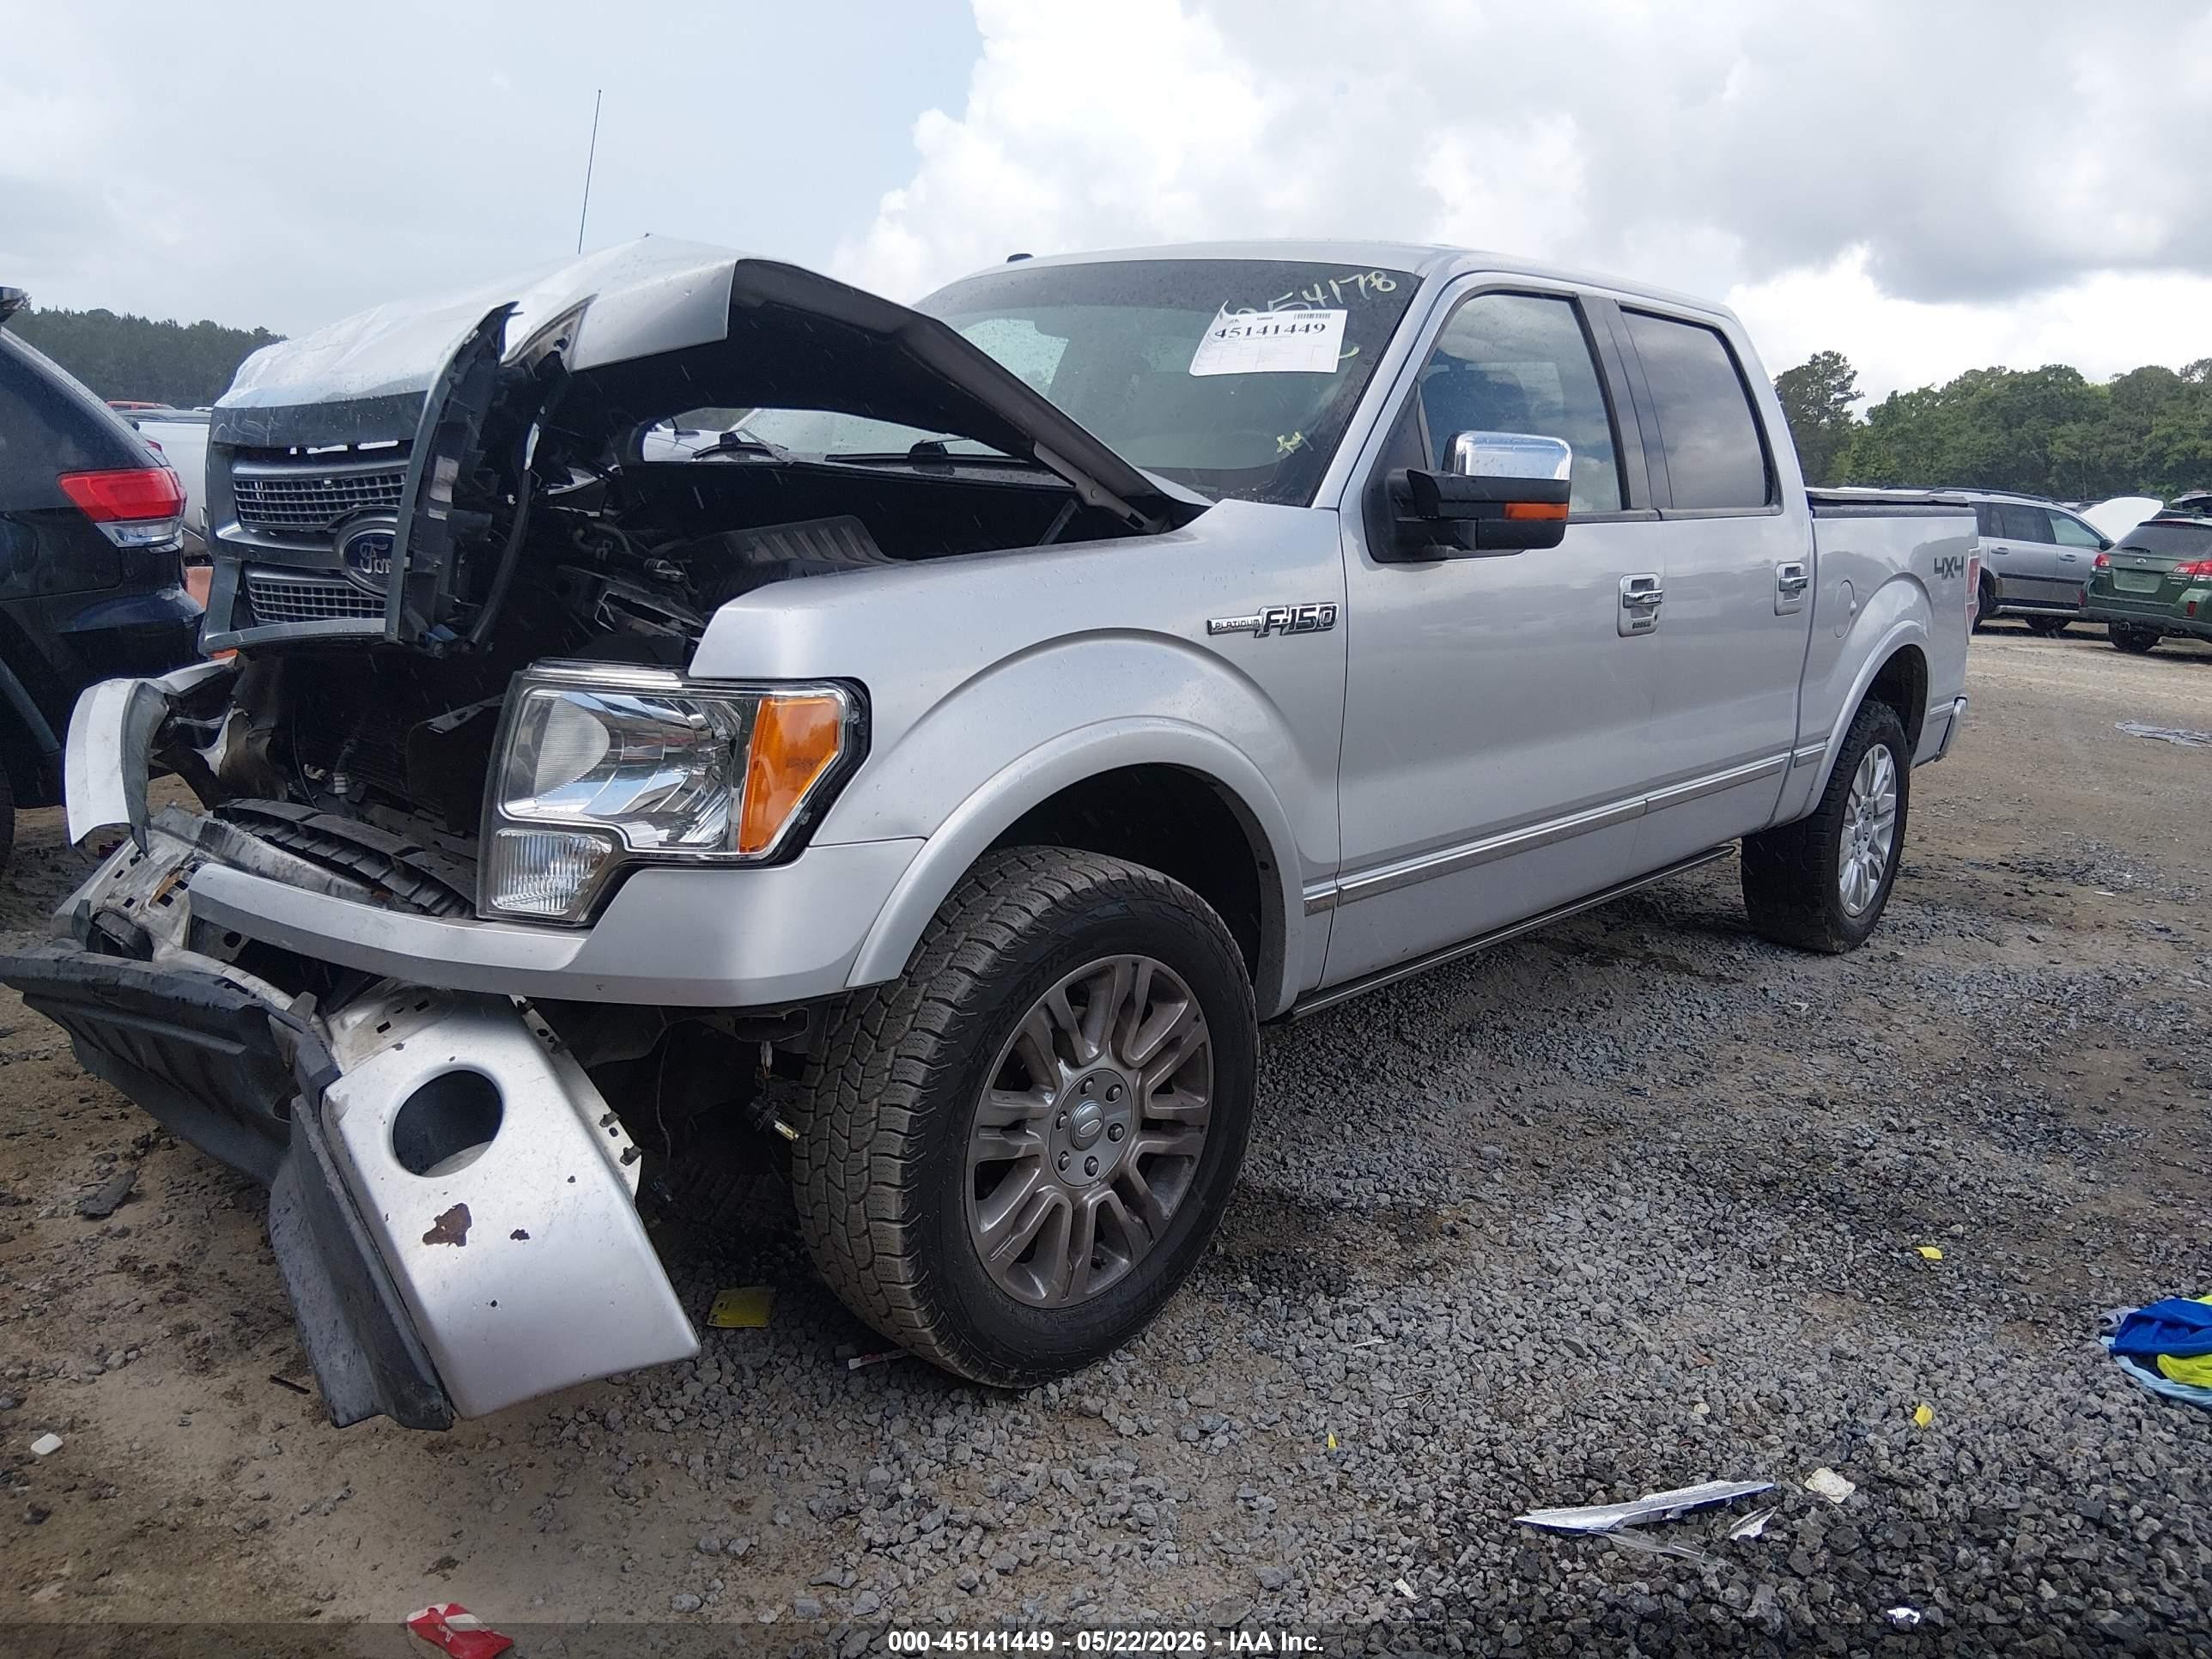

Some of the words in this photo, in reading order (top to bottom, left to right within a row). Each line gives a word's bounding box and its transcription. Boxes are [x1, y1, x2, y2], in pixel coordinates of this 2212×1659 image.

[1214, 322, 1327, 339] 45141449
[1212, 618, 1261, 630] PLATINUM
[1261, 603, 1340, 635] F-150
